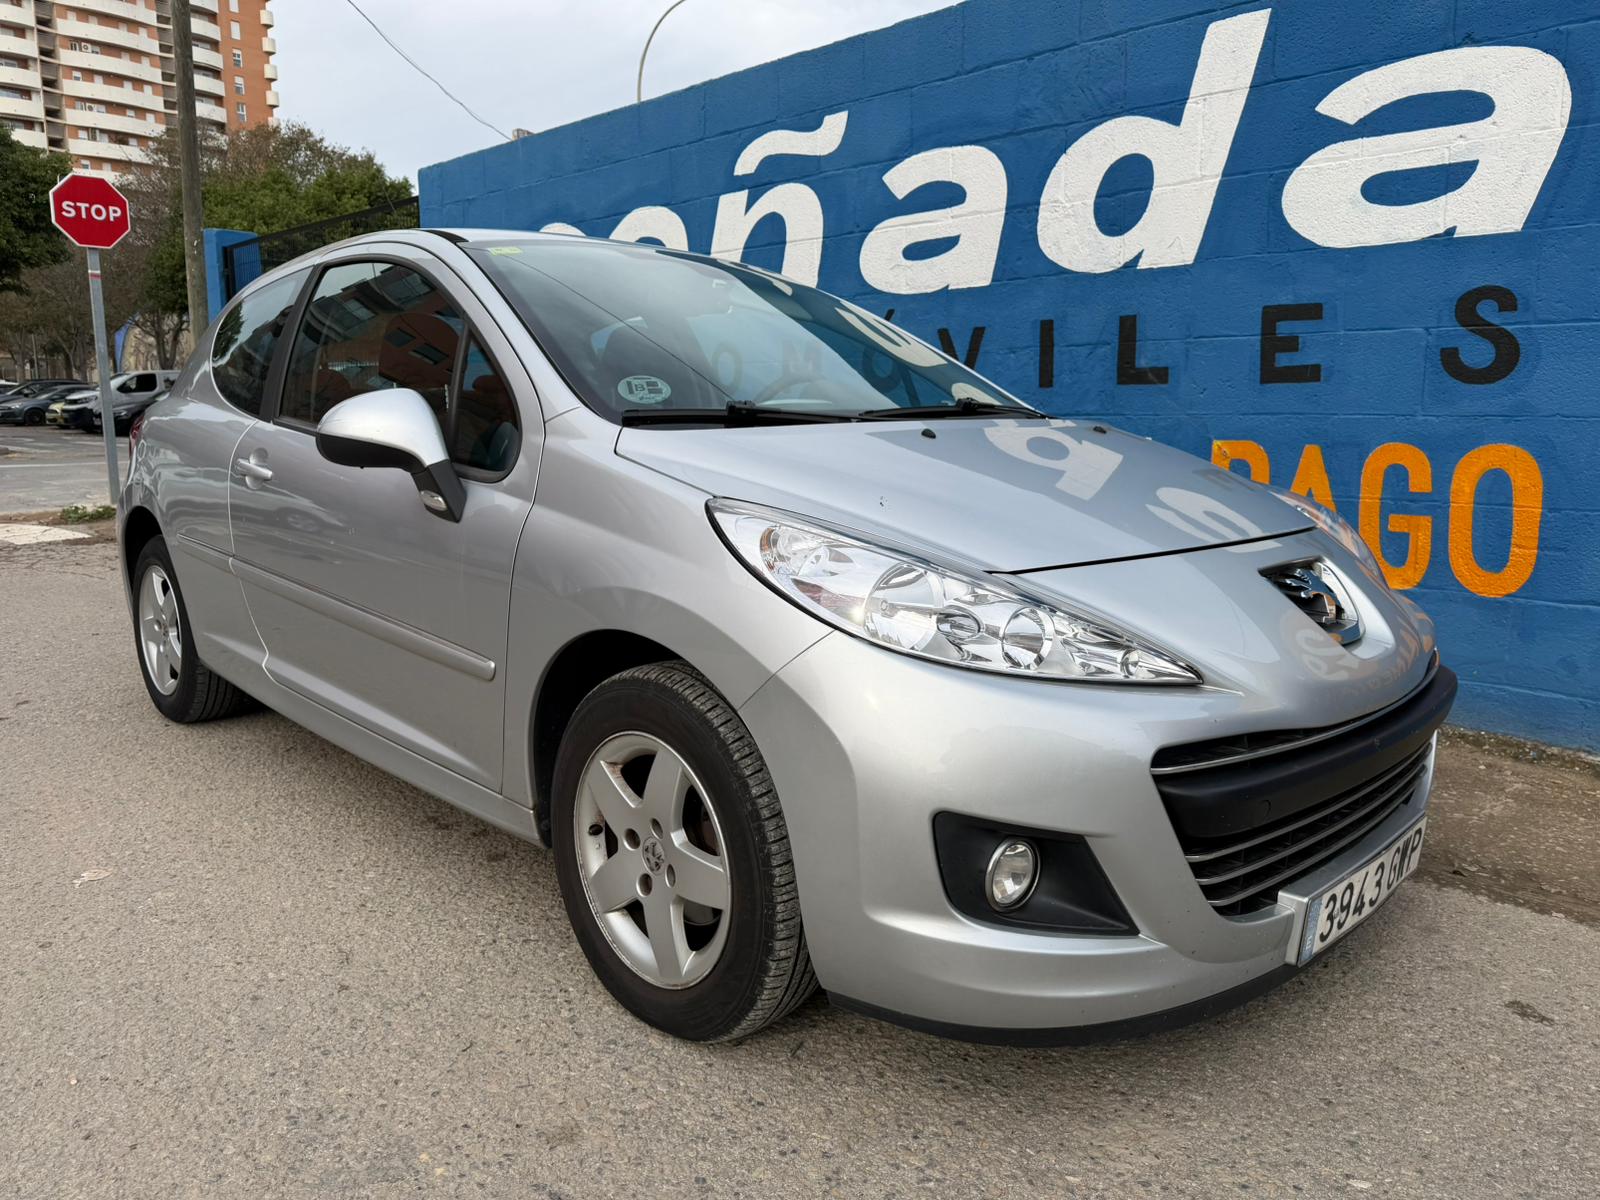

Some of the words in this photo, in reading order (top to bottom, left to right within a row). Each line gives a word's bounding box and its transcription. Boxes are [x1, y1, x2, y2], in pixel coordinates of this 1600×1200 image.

[539, 8, 1572, 292] ñada
[61, 200, 122, 222] STOP
[1319, 861, 1386, 943] 3943
[1387, 827, 1423, 891] GWP
